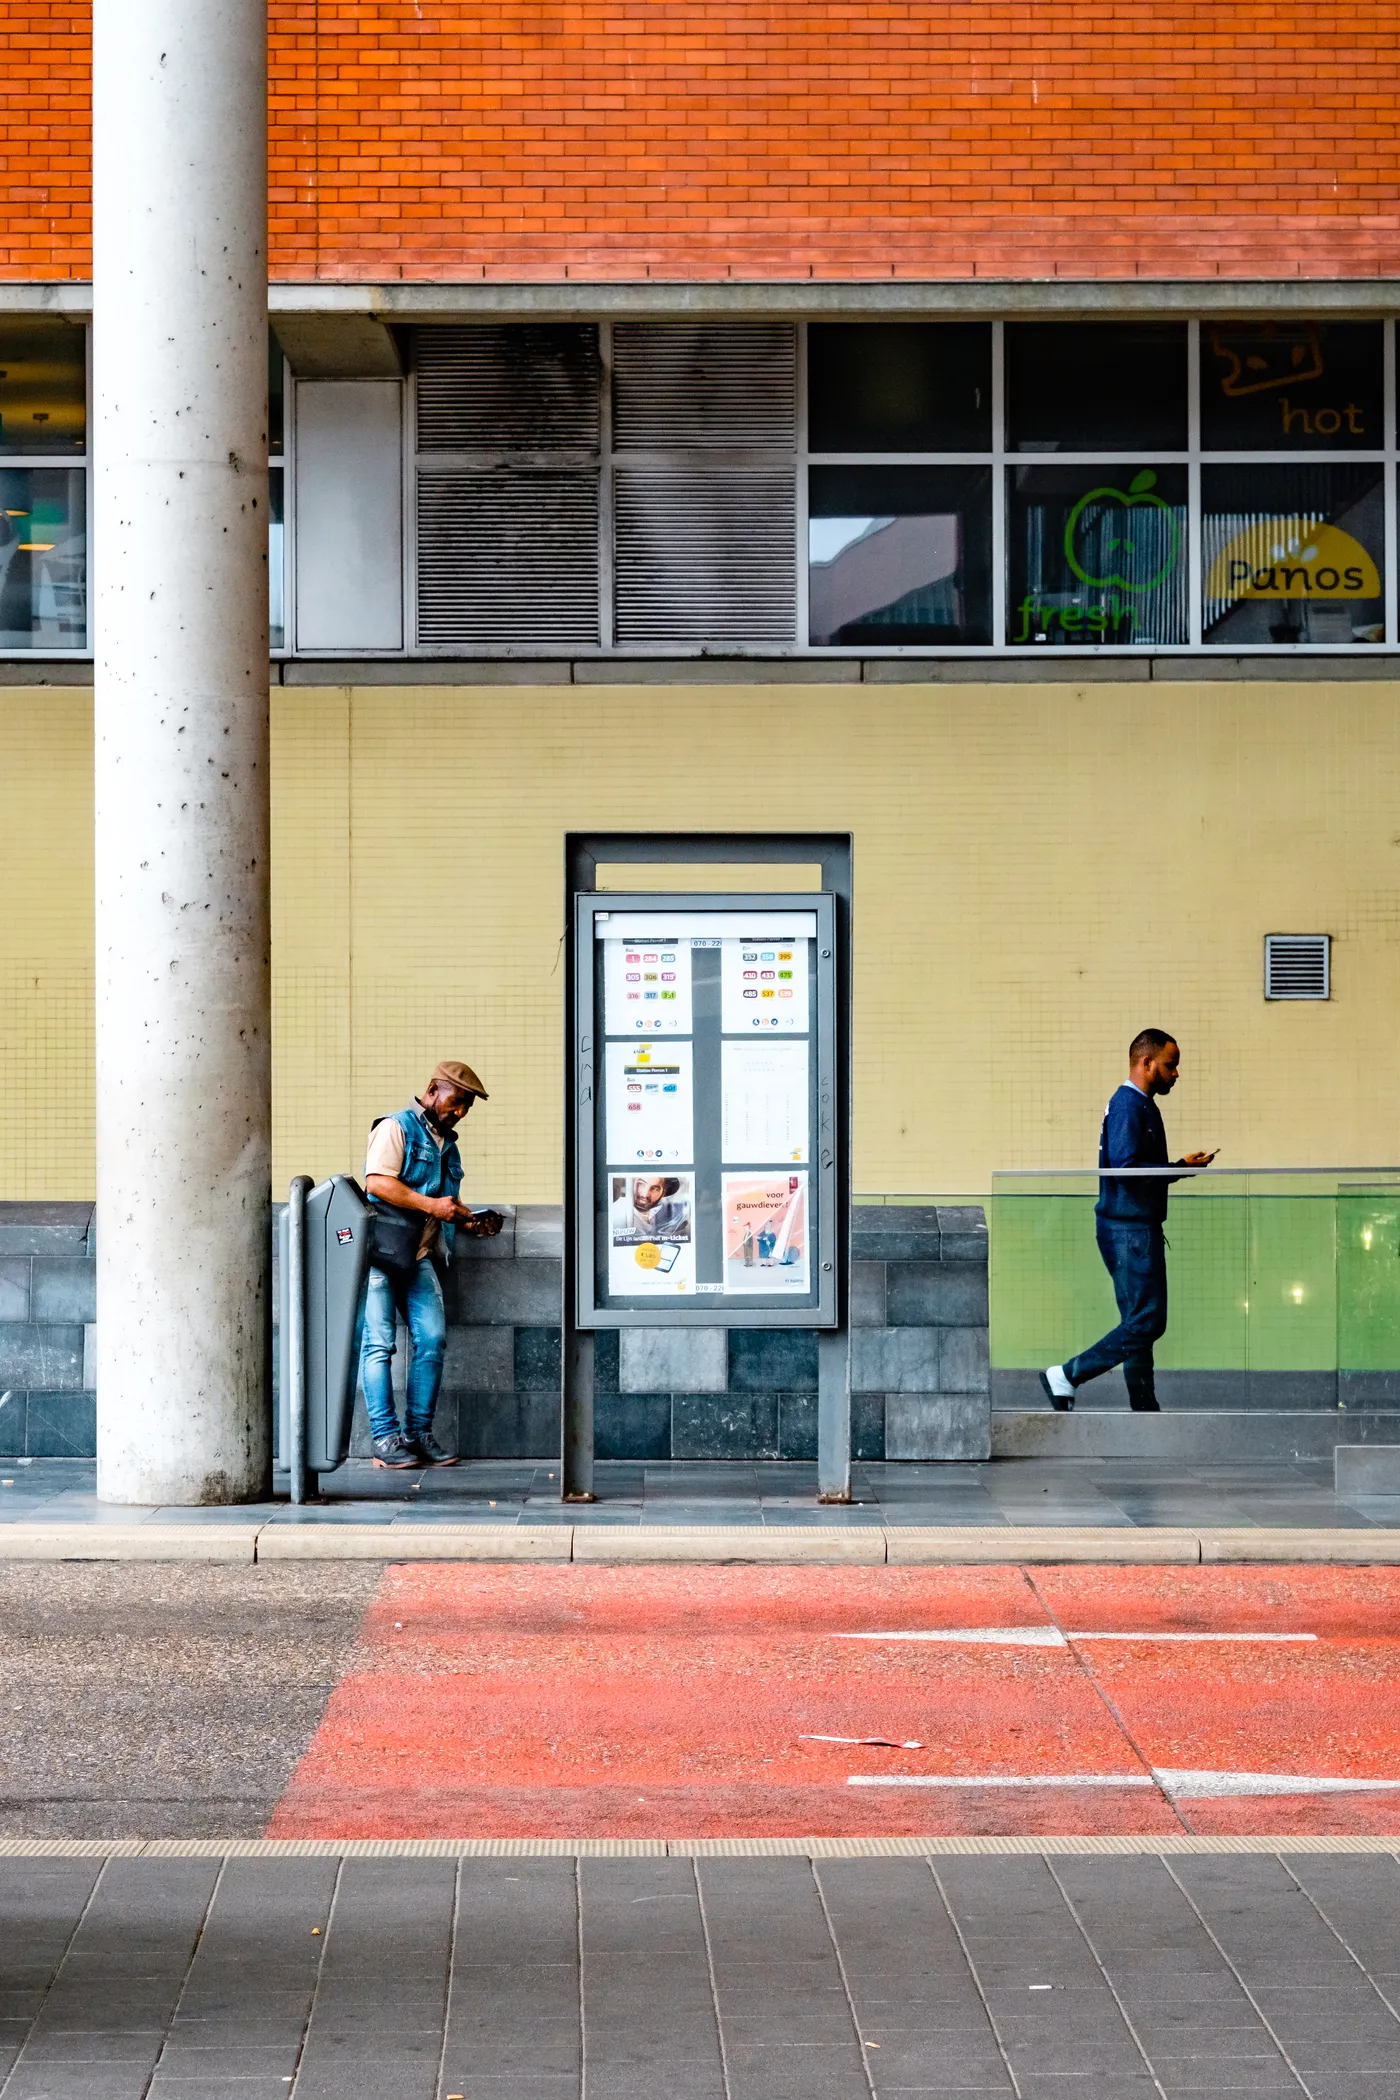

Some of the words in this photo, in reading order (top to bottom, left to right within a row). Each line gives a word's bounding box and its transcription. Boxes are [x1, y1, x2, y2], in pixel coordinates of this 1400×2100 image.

[1278, 398, 1365, 434] hot
[1229, 560, 1364, 592] Panos
[1013, 595, 1142, 642] fresh
[613, 1228, 635, 1236] Nieuw
